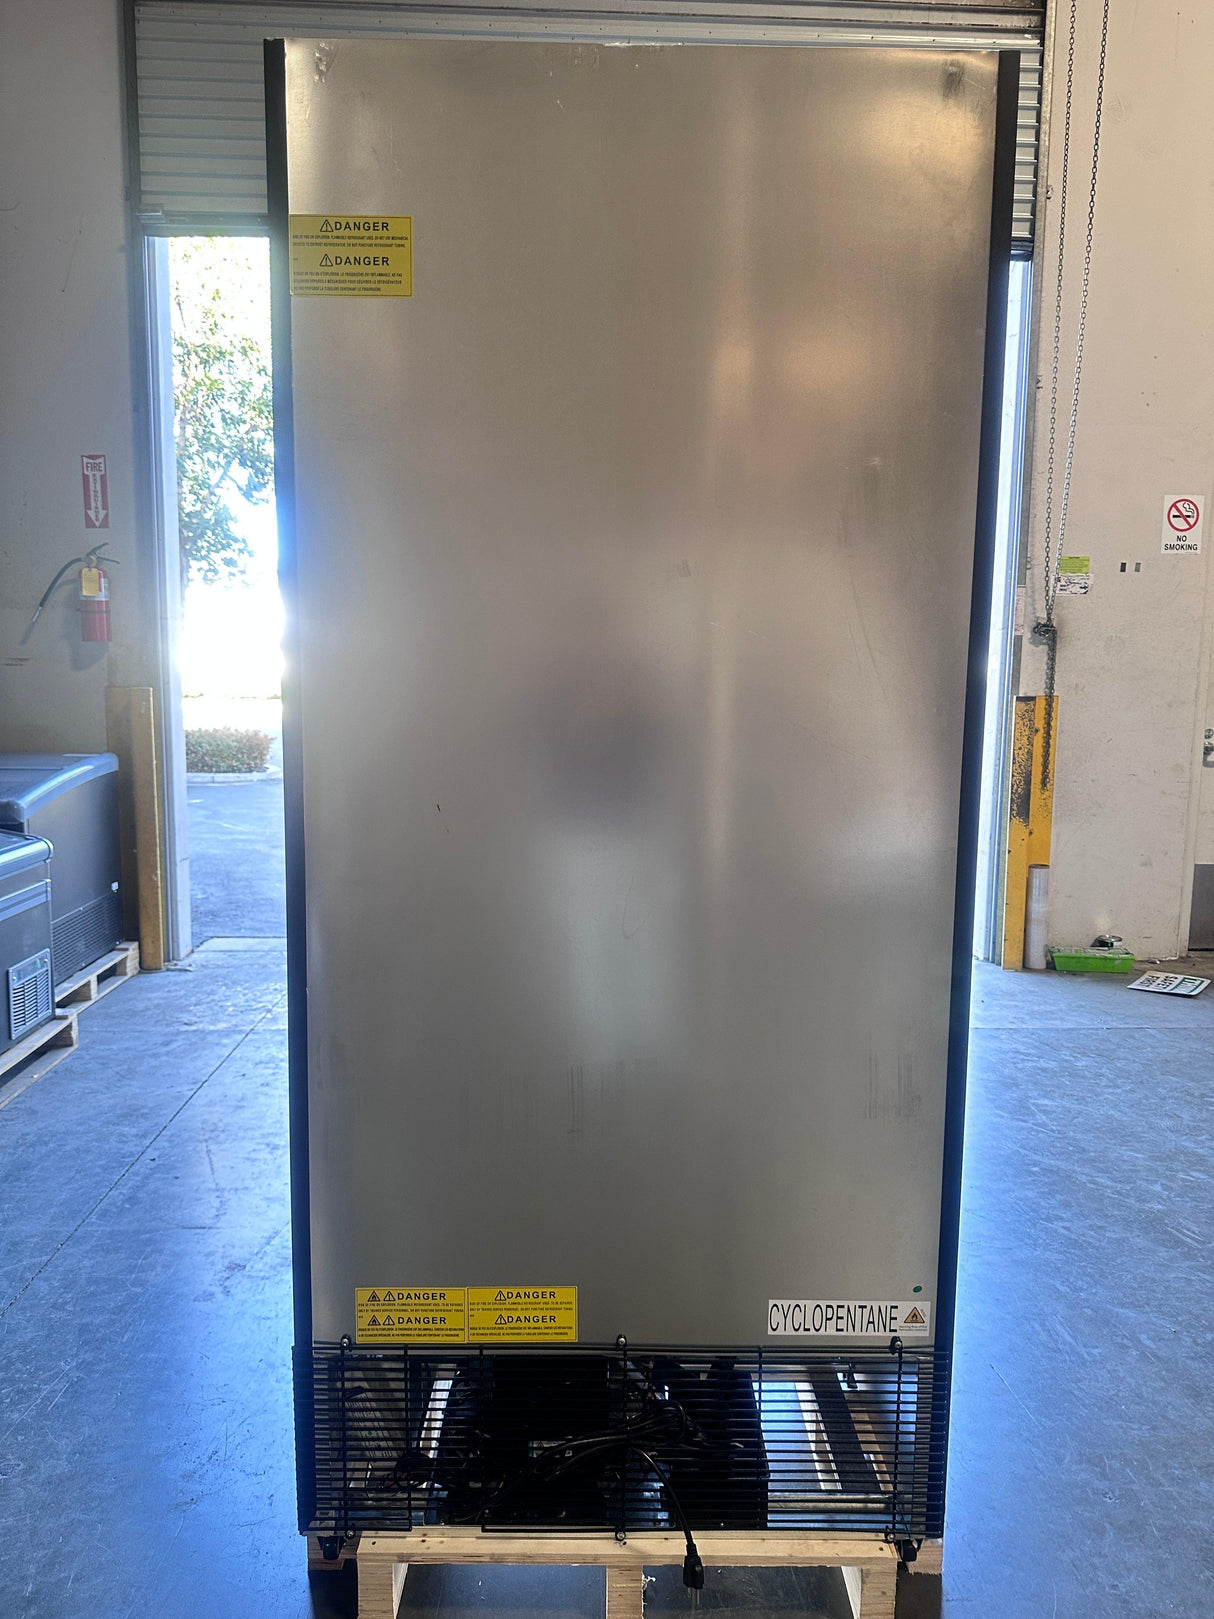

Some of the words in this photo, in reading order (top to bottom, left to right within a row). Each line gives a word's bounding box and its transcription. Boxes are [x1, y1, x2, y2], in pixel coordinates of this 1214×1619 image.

[335, 221, 390, 231] DANGER
[335, 256, 390, 266] DANGER
[86, 461, 103, 472] FIRE
[1164, 543, 1198, 551] SMOKING
[397, 1292, 446, 1300] DANGER
[506, 1291, 556, 1299] DANGER
[397, 1317, 447, 1325] DANGER
[507, 1315, 557, 1323] DANGER
[769, 1303, 899, 1333] CYCLOPENTANE
